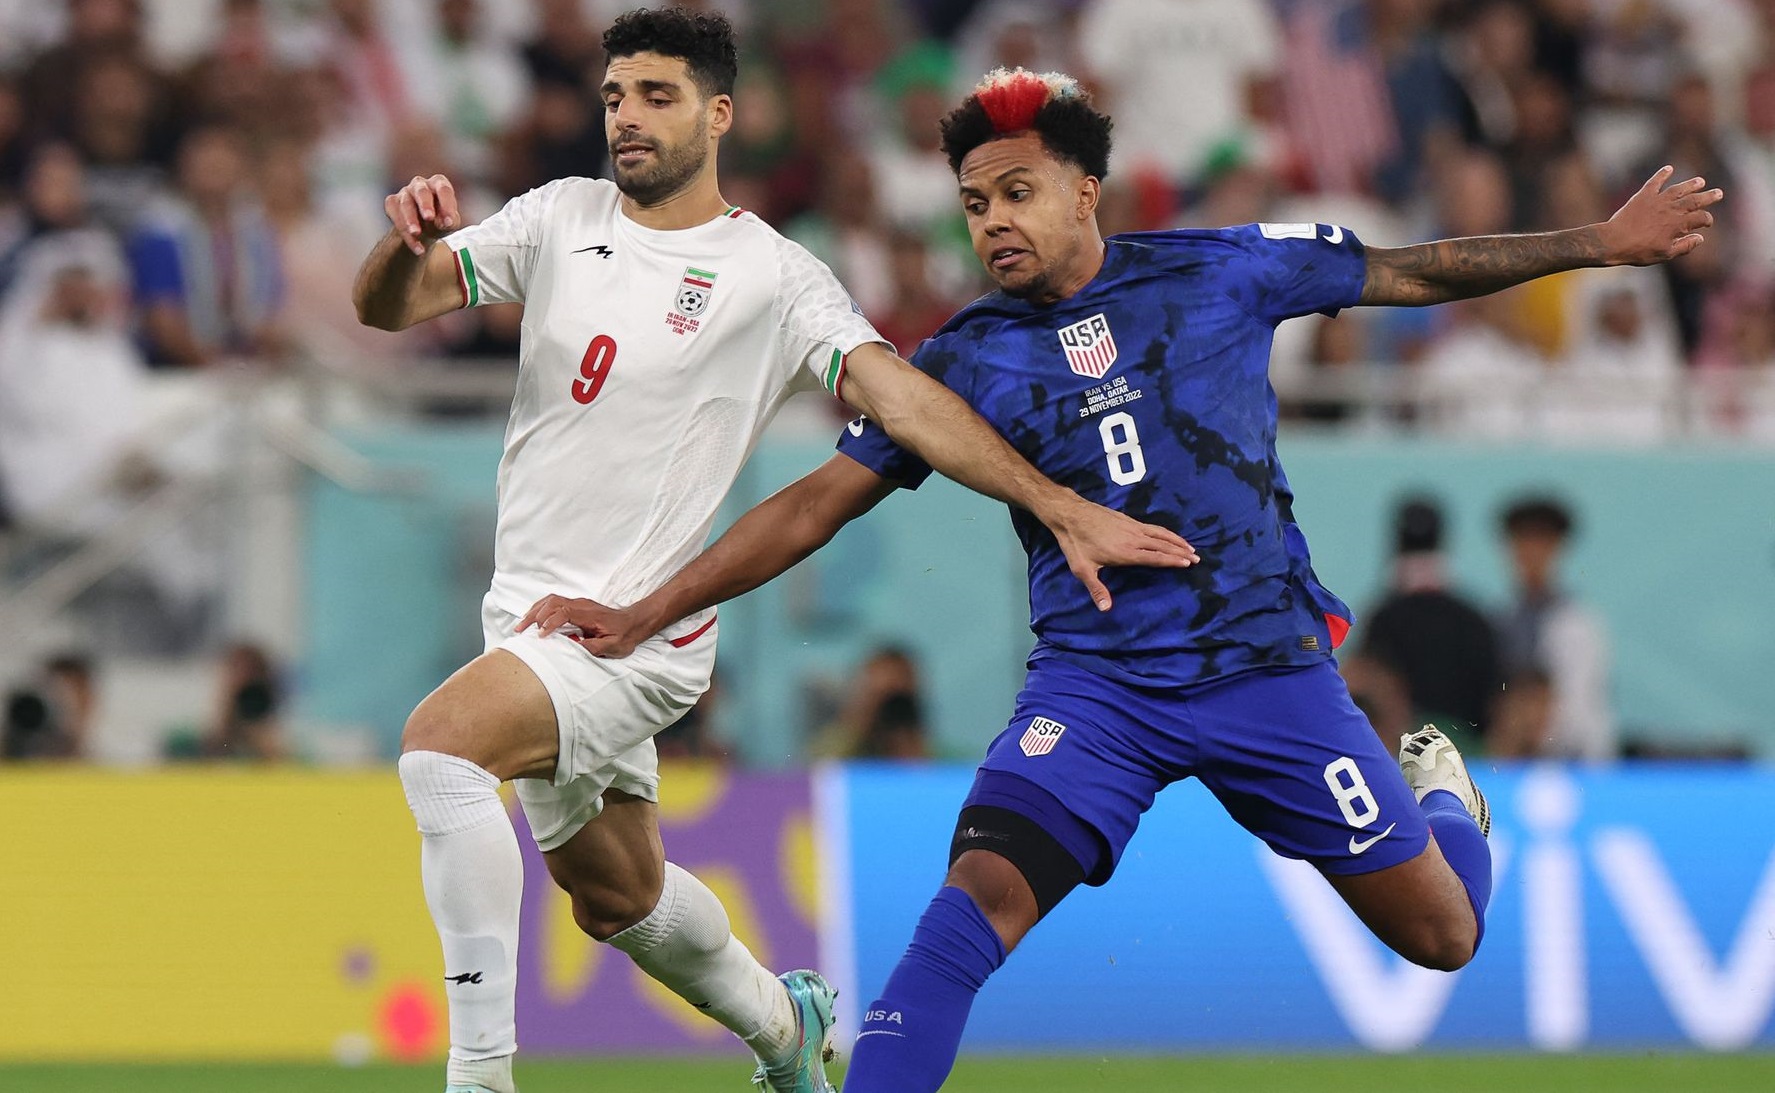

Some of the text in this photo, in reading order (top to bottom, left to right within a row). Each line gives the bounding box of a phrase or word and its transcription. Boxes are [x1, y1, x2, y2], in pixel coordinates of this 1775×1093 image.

[1062, 317, 1106, 347] USA
[571, 334, 617, 405] 9
[1084, 376, 1127, 397] IRAN VS. USA
[1107, 385, 1129, 398] QATAR
[1078, 389, 1143, 418] 29 NOVEMBER 2022
[1098, 411, 1147, 487] 8
[1032, 718, 1062, 736] USA
[1323, 756, 1380, 829] 8
[864, 1009, 902, 1025] USA
